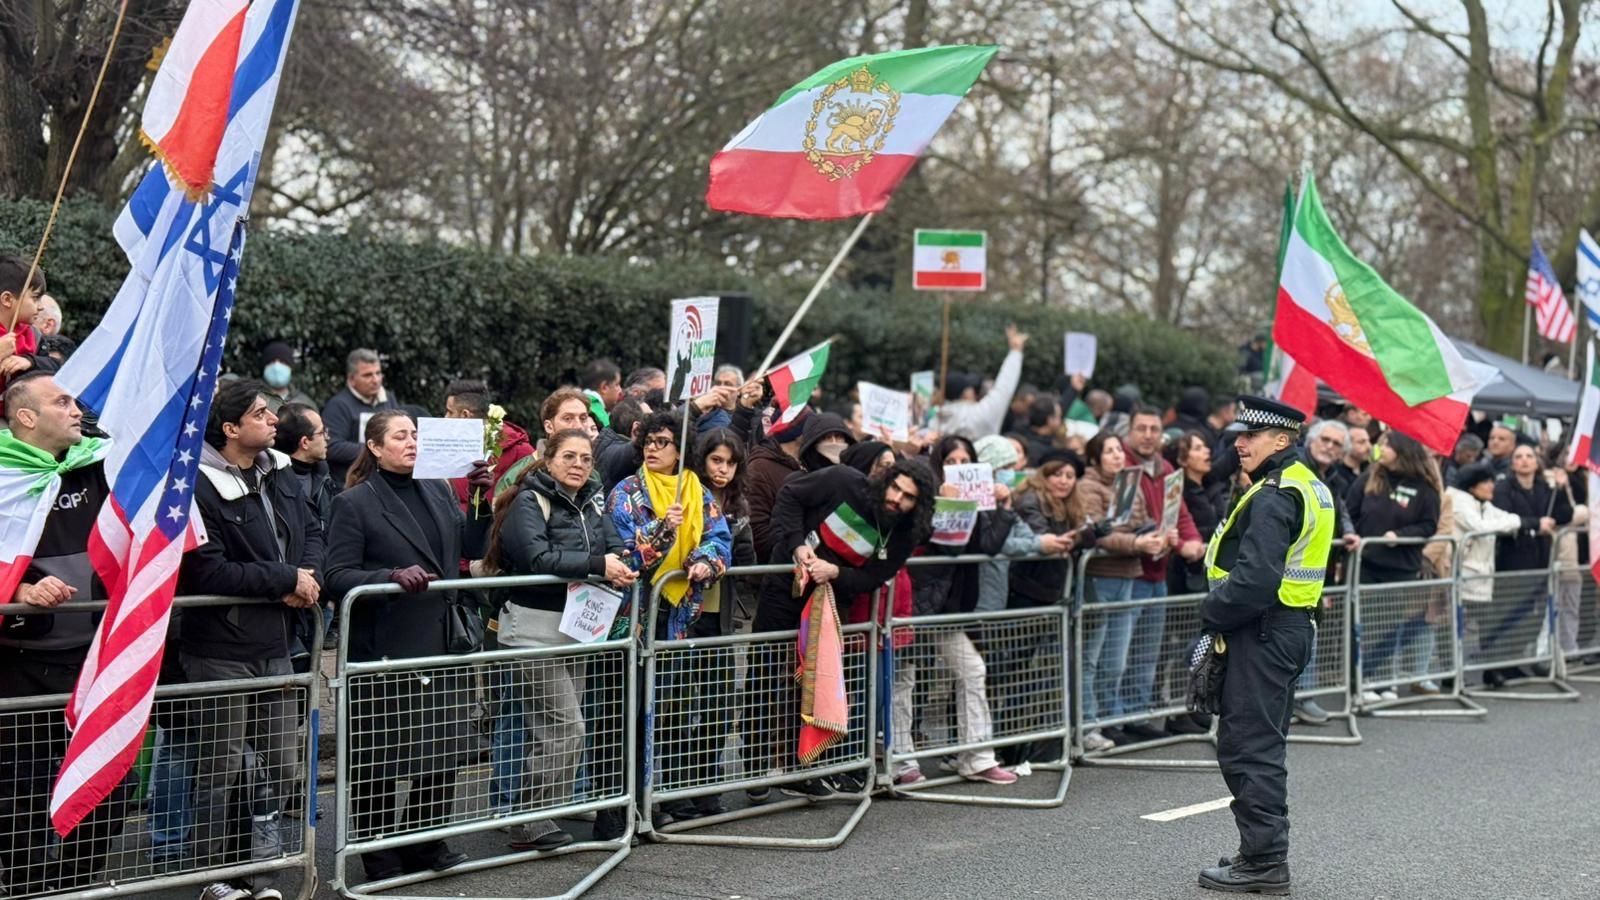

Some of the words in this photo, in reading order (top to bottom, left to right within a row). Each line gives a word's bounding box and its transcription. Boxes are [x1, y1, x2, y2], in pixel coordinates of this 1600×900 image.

[690, 375, 711, 396] OUT
[958, 468, 979, 482] NOT
[585, 598, 605, 613] KING
[581, 608, 599, 624] REZA
